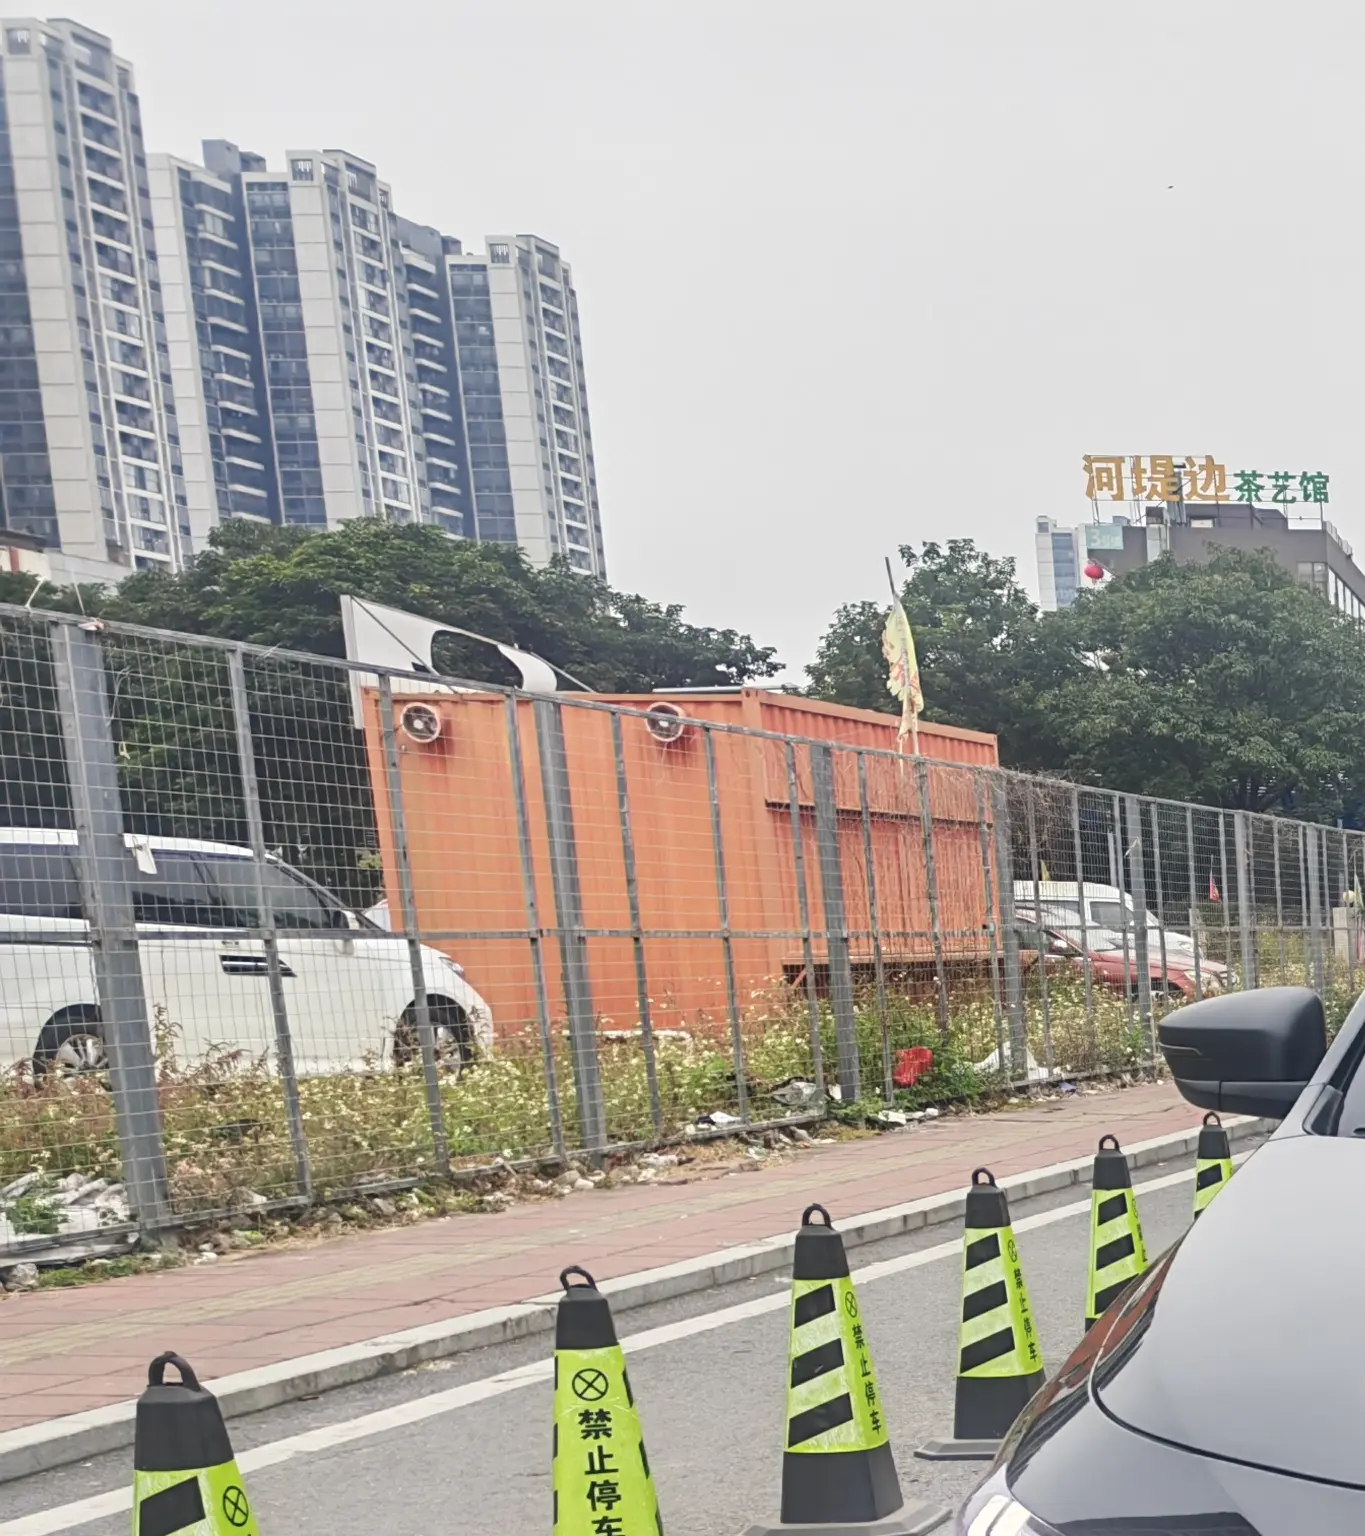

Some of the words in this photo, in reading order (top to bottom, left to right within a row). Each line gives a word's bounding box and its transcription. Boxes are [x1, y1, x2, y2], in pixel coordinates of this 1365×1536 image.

[1082, 453, 1230, 501] 河堤边
[1233, 469, 1329, 503] 茶艺馆
[852, 1323, 882, 1435] 禁止停车
